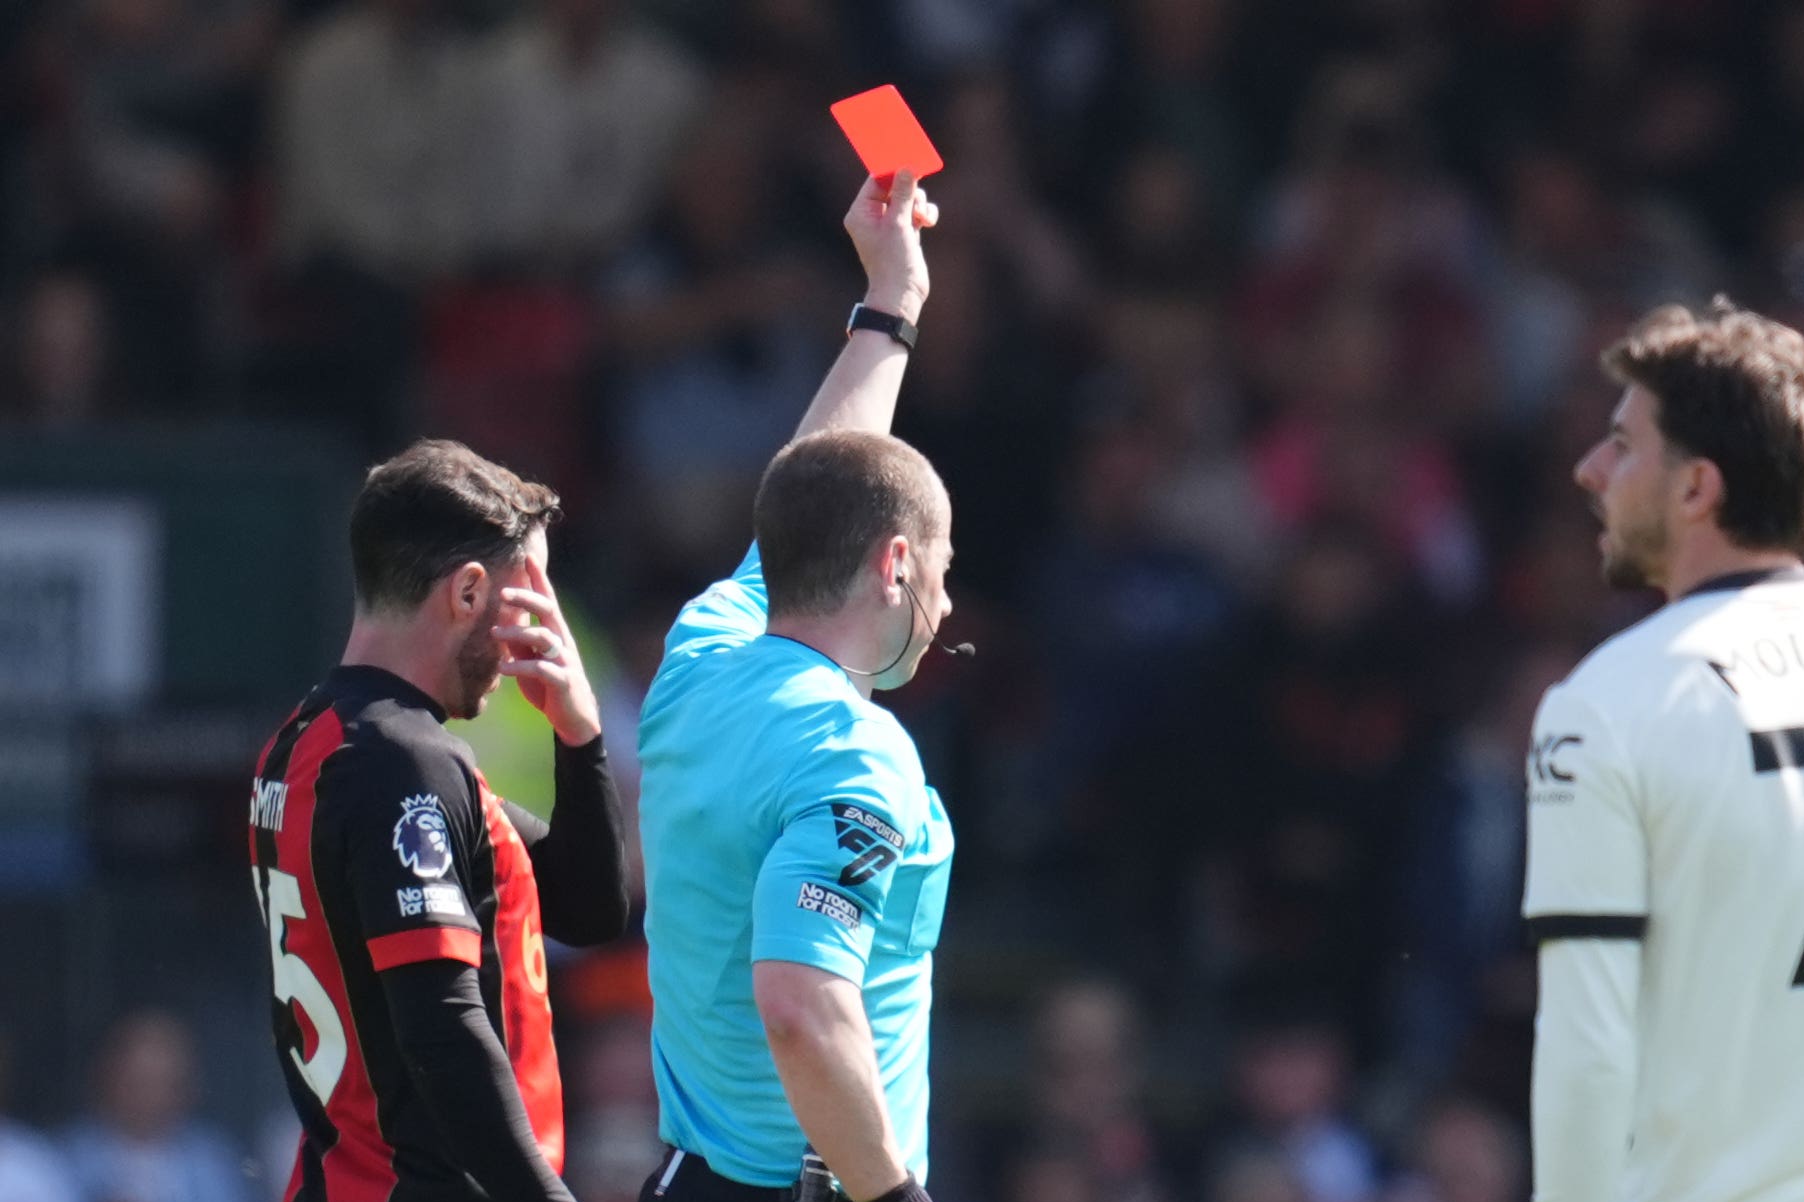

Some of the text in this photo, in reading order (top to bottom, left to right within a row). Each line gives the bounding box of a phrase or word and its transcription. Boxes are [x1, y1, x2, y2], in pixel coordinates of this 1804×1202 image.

[862, 812, 904, 848] SPORTS
[397, 887, 422, 902] No
[801, 882, 859, 919] No room
